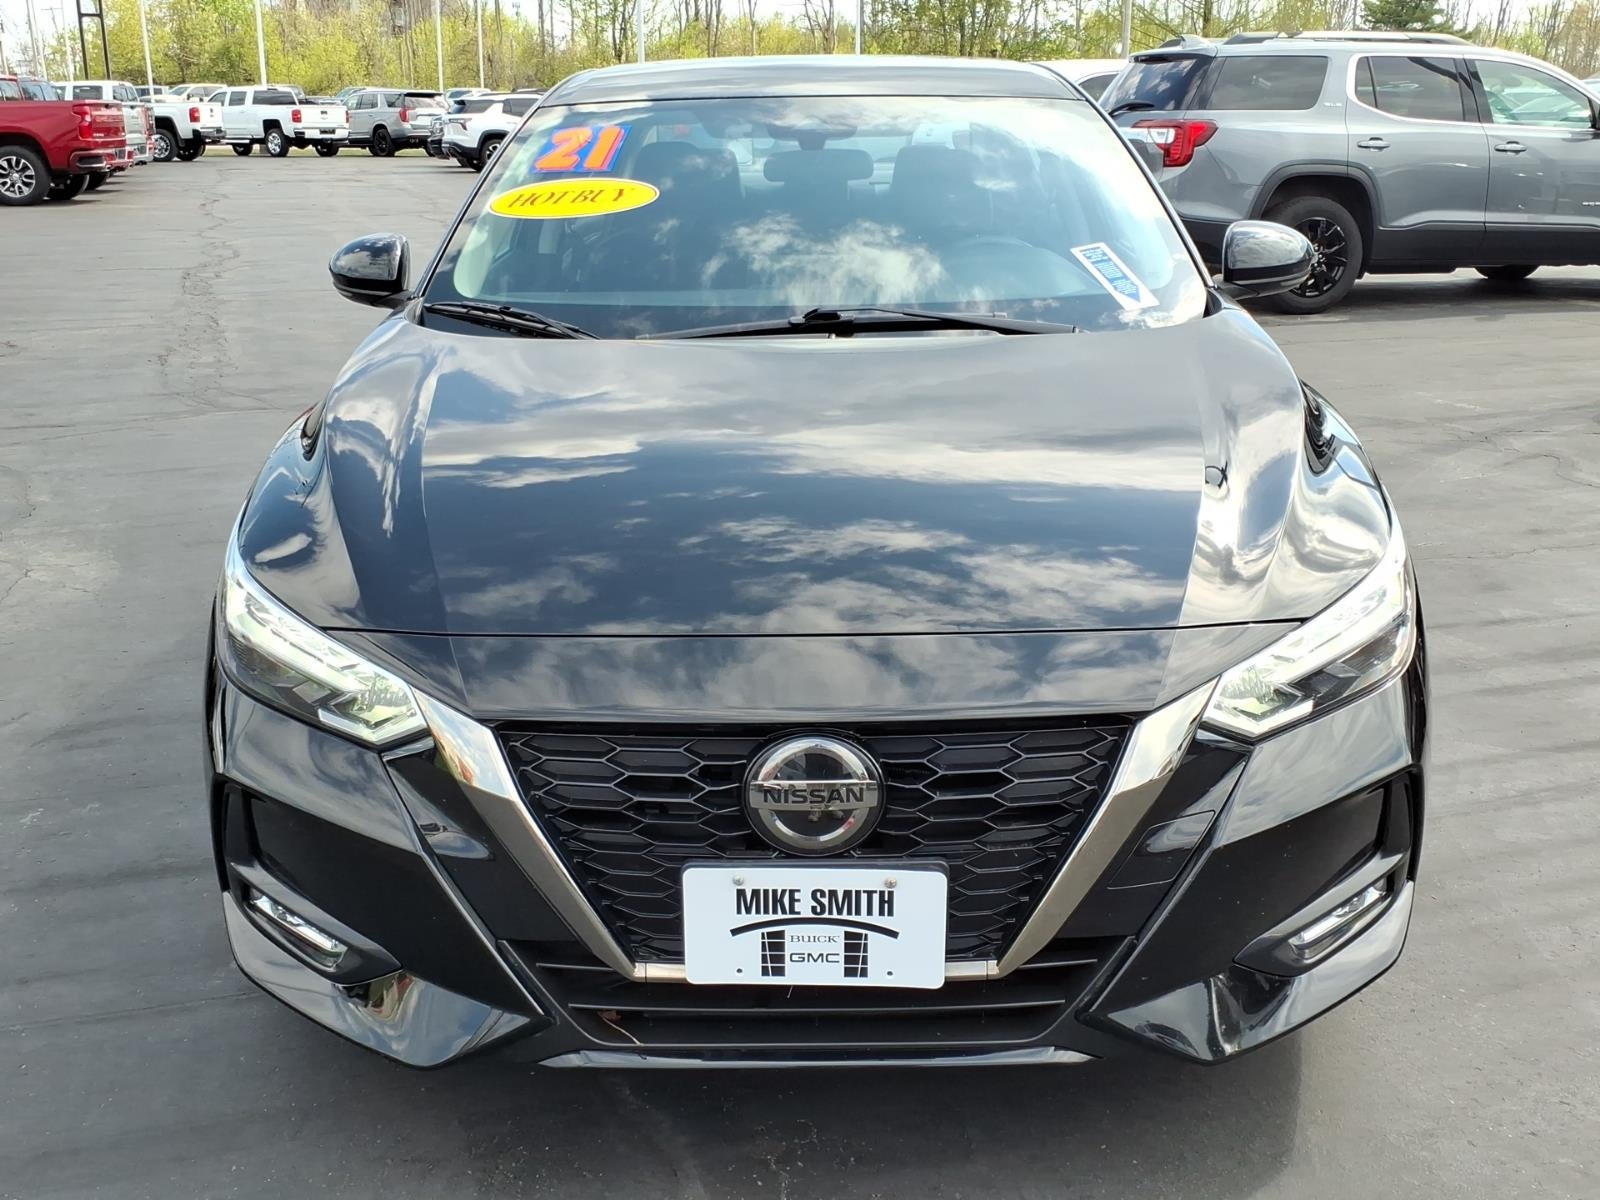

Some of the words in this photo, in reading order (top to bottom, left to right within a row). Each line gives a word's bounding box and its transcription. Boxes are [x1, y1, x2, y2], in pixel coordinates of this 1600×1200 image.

[533, 126, 626, 171] 21
[508, 191, 574, 208] HOT
[763, 789, 864, 804] NISSAN
[736, 888, 801, 915] MIKE
[810, 889, 895, 917] SMITH
[790, 934, 839, 943] BUICK
[789, 952, 840, 963] GMC
